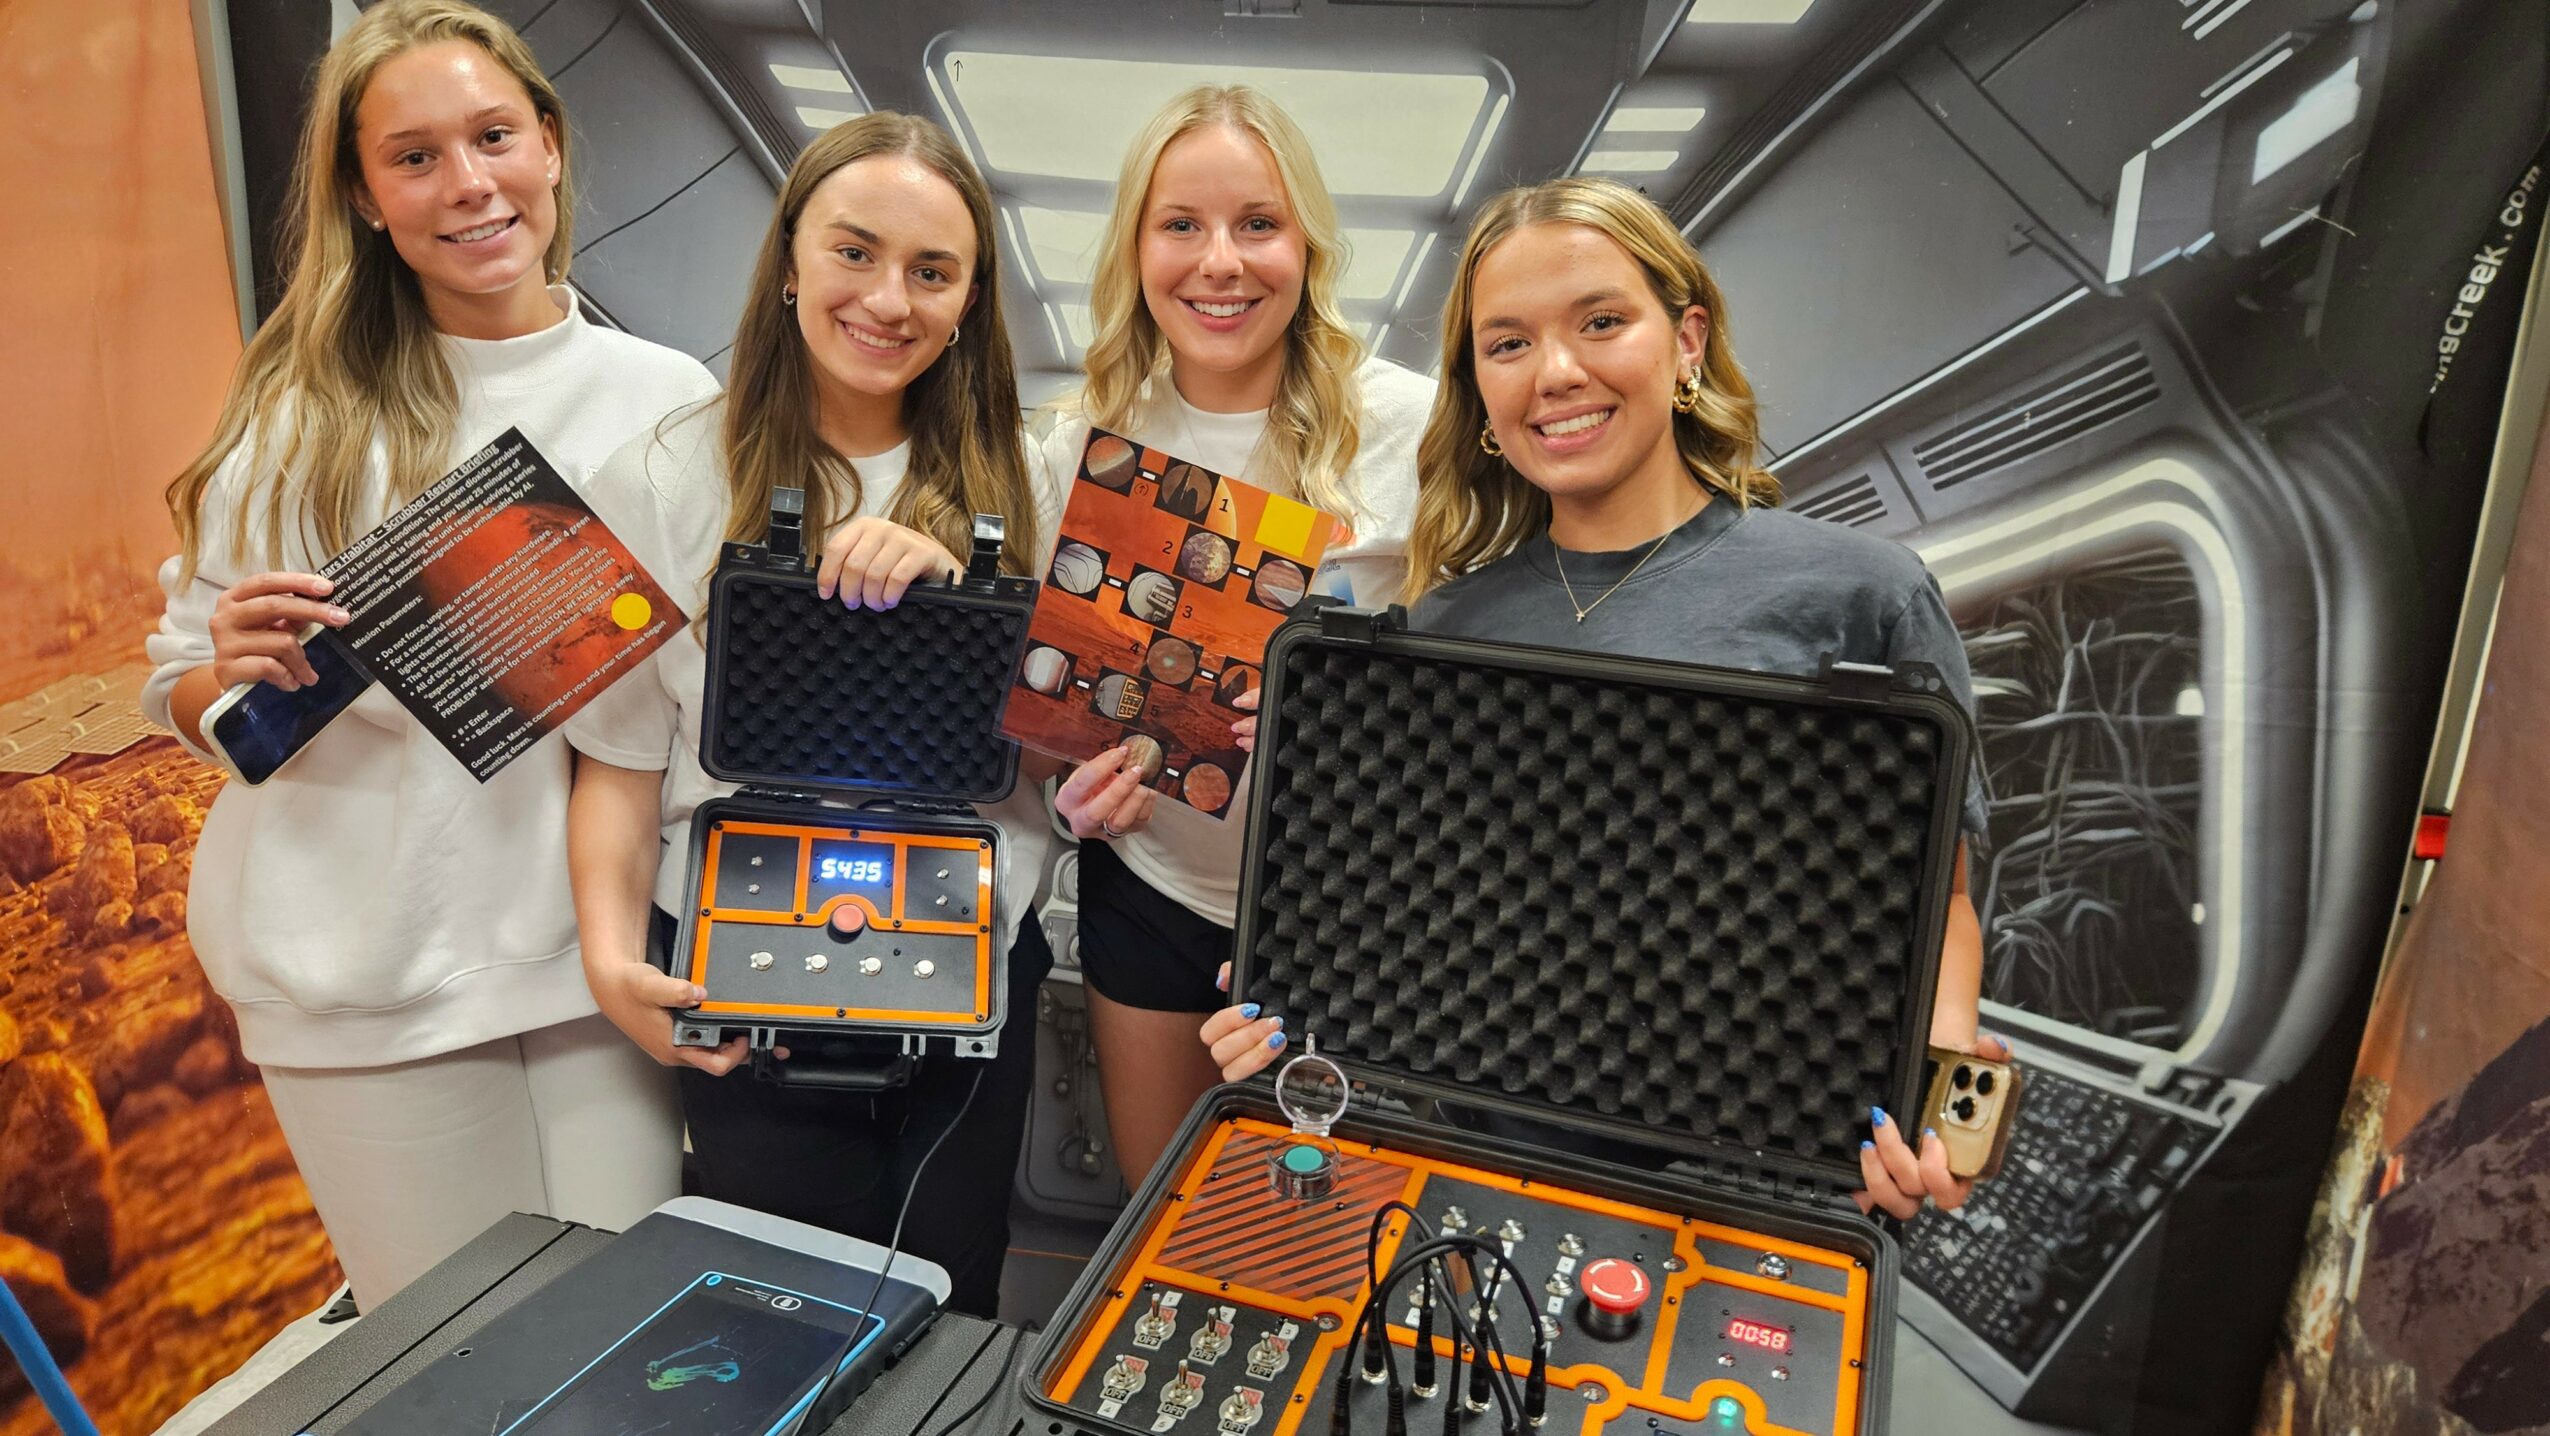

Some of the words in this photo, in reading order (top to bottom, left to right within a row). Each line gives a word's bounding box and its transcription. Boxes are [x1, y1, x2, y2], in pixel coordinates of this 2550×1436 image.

[338, 531, 378, 563] Habitat
[380, 494, 428, 532] Scrubber
[424, 469, 462, 500] Restart
[457, 442, 501, 477] Briefing
[345, 561, 385, 592] recapture
[380, 549, 400, 565] unit
[402, 527, 430, 549] failing
[425, 517, 443, 532] and
[440, 507, 459, 522] you
[454, 493, 475, 511] have
[481, 464, 513, 490] minutes
[349, 571, 392, 605] remaining.
[387, 544, 428, 577] Restarting
[423, 535, 440, 549] the
[436, 523, 455, 539] unit
[452, 501, 485, 529] requires
[480, 482, 511, 507] solving
[511, 462, 537, 483] series
[362, 540, 391, 564] critical
[387, 513, 427, 545] condition.
[423, 503, 441, 518] The
[437, 484, 467, 508] carbon
[463, 464, 493, 489] dioxide
[489, 441, 524, 469] scrubber
[393, 563, 424, 588] puzzles
[419, 538, 457, 568] designed
[470, 494, 514, 529] unhackable
[1162, 541, 1173, 554] 2
[1219, 498, 1229, 512] 1
[350, 624, 382, 650] Mission
[377, 593, 424, 629] Parameters:
[388, 653, 404, 667] For
[406, 622, 446, 654] successful
[443, 608, 465, 626] reset
[461, 598, 477, 612] the
[474, 585, 495, 603] main
[492, 566, 521, 590] control
[518, 551, 542, 571] panel
[568, 515, 592, 535] green
[391, 636, 408, 650] not
[460, 575, 490, 599] tamper
[486, 562, 505, 579] with
[502, 553, 520, 568] any
[397, 656, 422, 677] lights
[417, 644, 437, 661] then
[434, 634, 450, 648] the
[446, 620, 469, 640] large
[465, 606, 490, 626] green
[484, 586, 514, 609] button
[405, 669, 423, 684] The
[419, 646, 454, 674] 9-button
[450, 629, 477, 651] puzzle
[472, 610, 500, 633] should
[507, 583, 539, 609] pressed
[413, 681, 428, 693] All
[433, 665, 449, 679] the
[445, 634, 490, 669] information
[486, 614, 516, 638] needed
[528, 594, 543, 608] the
[567, 563, 585, 578] You
[582, 556, 596, 568] are
[592, 545, 609, 560] the
[455, 663, 472, 677] but
[475, 648, 493, 663] you
[488, 622, 527, 652] encounter
[525, 612, 542, 627] any
[591, 555, 616, 575] issues
[1182, 605, 1193, 618] 3
[431, 696, 449, 712] you
[446, 687, 462, 700] can
[458, 671, 480, 690] radio
[477, 653, 506, 677] (loudly
[575, 584, 597, 602] HAVE
[477, 675, 495, 690] and
[491, 664, 510, 680] wait
[506, 655, 521, 668] for
[517, 646, 534, 660] the
[532, 623, 566, 651] response
[562, 609, 582, 627] from
[579, 584, 617, 615] lightyears
[1130, 642, 1141, 655] 4
[467, 708, 490, 727] Enter
[469, 750, 492, 769] Good
[505, 724, 526, 742] Mars
[530, 696, 565, 725] counting
[571, 680, 588, 694] you
[584, 669, 600, 683] and
[598, 657, 618, 674] your
[613, 644, 633, 661] time
[629, 634, 646, 648] has
[642, 618, 668, 640] begun
[474, 704, 515, 737] Backspace
[1150, 704, 1159, 716] 5
[477, 749, 513, 778] counting
[821, 858, 882, 882] 5435
[1105, 1387, 1129, 1399] OFF
[1162, 1403, 1185, 1416] OFF
[1223, 1420, 1246, 1433] OFF
